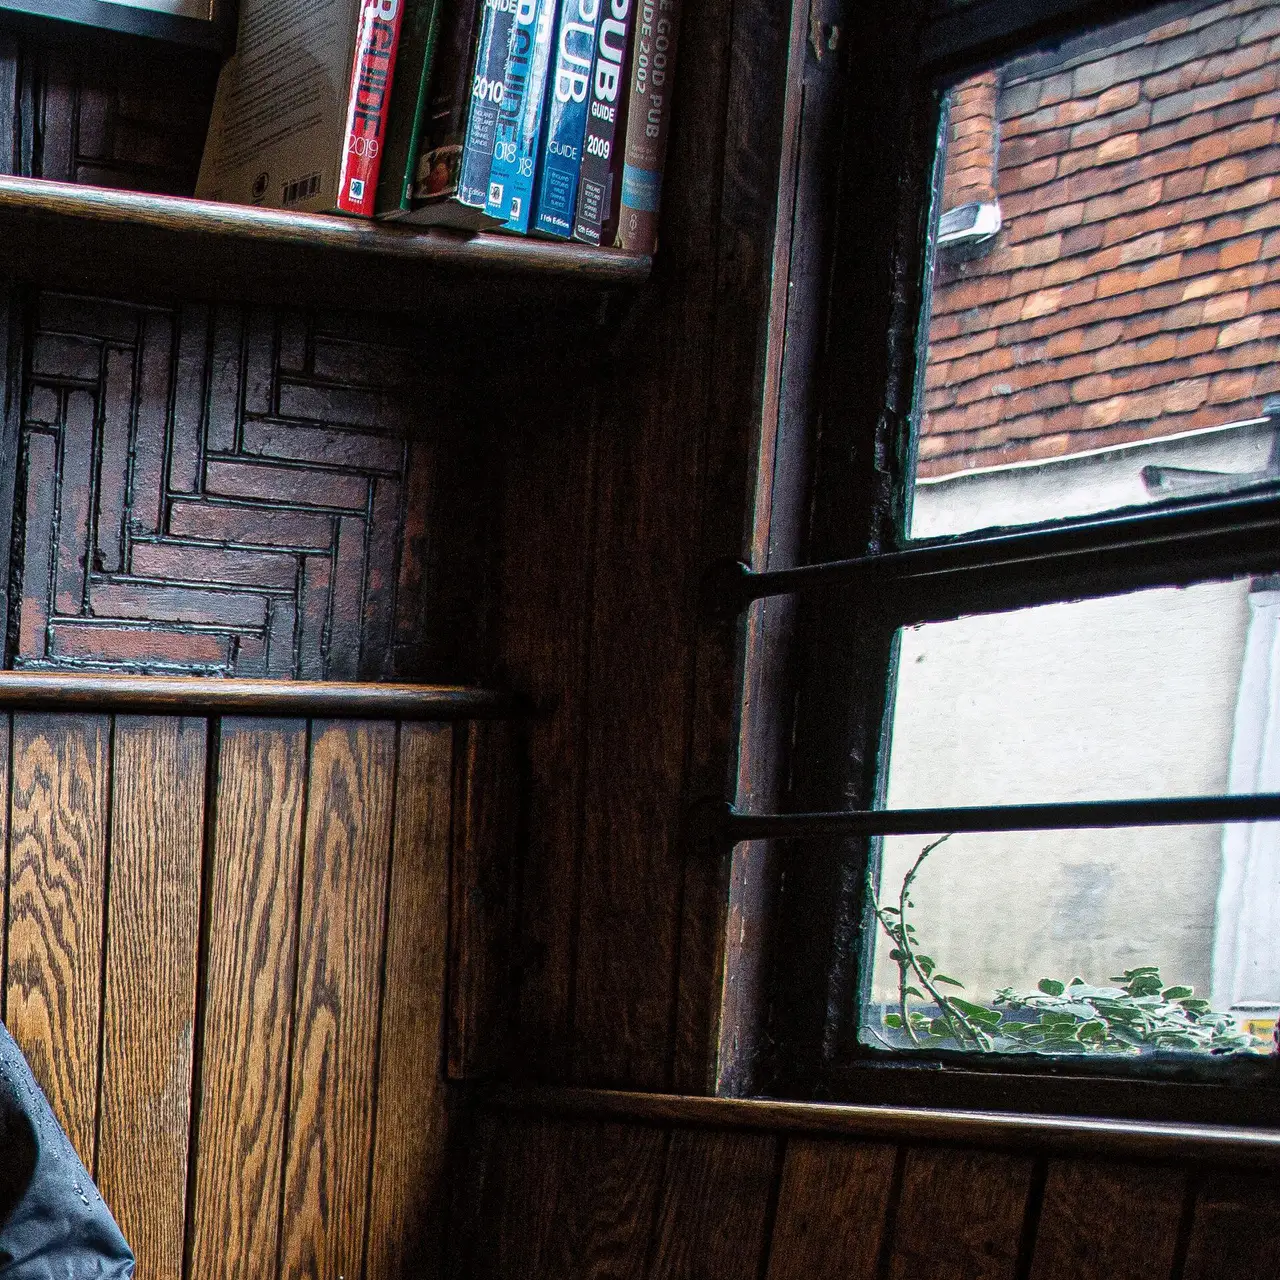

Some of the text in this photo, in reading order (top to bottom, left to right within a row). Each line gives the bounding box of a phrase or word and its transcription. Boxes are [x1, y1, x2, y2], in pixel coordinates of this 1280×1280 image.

[635, 0, 654, 94] IDE 2002
[651, 18, 671, 87] GOOD
[352, 22, 394, 138] GUIDE
[473, 74, 504, 104] 2010
[591, 101, 615, 123] GUIDE
[645, 94, 663, 138] PUB
[348, 135, 379, 159] 2019
[495, 142, 517, 164] 018
[549, 141, 578, 160] GUIDE
[587, 134, 610, 159] 2009
[516, 157, 532, 178] 18
[553, 217, 570, 229] Edition
[586, 227, 600, 239] Edition
